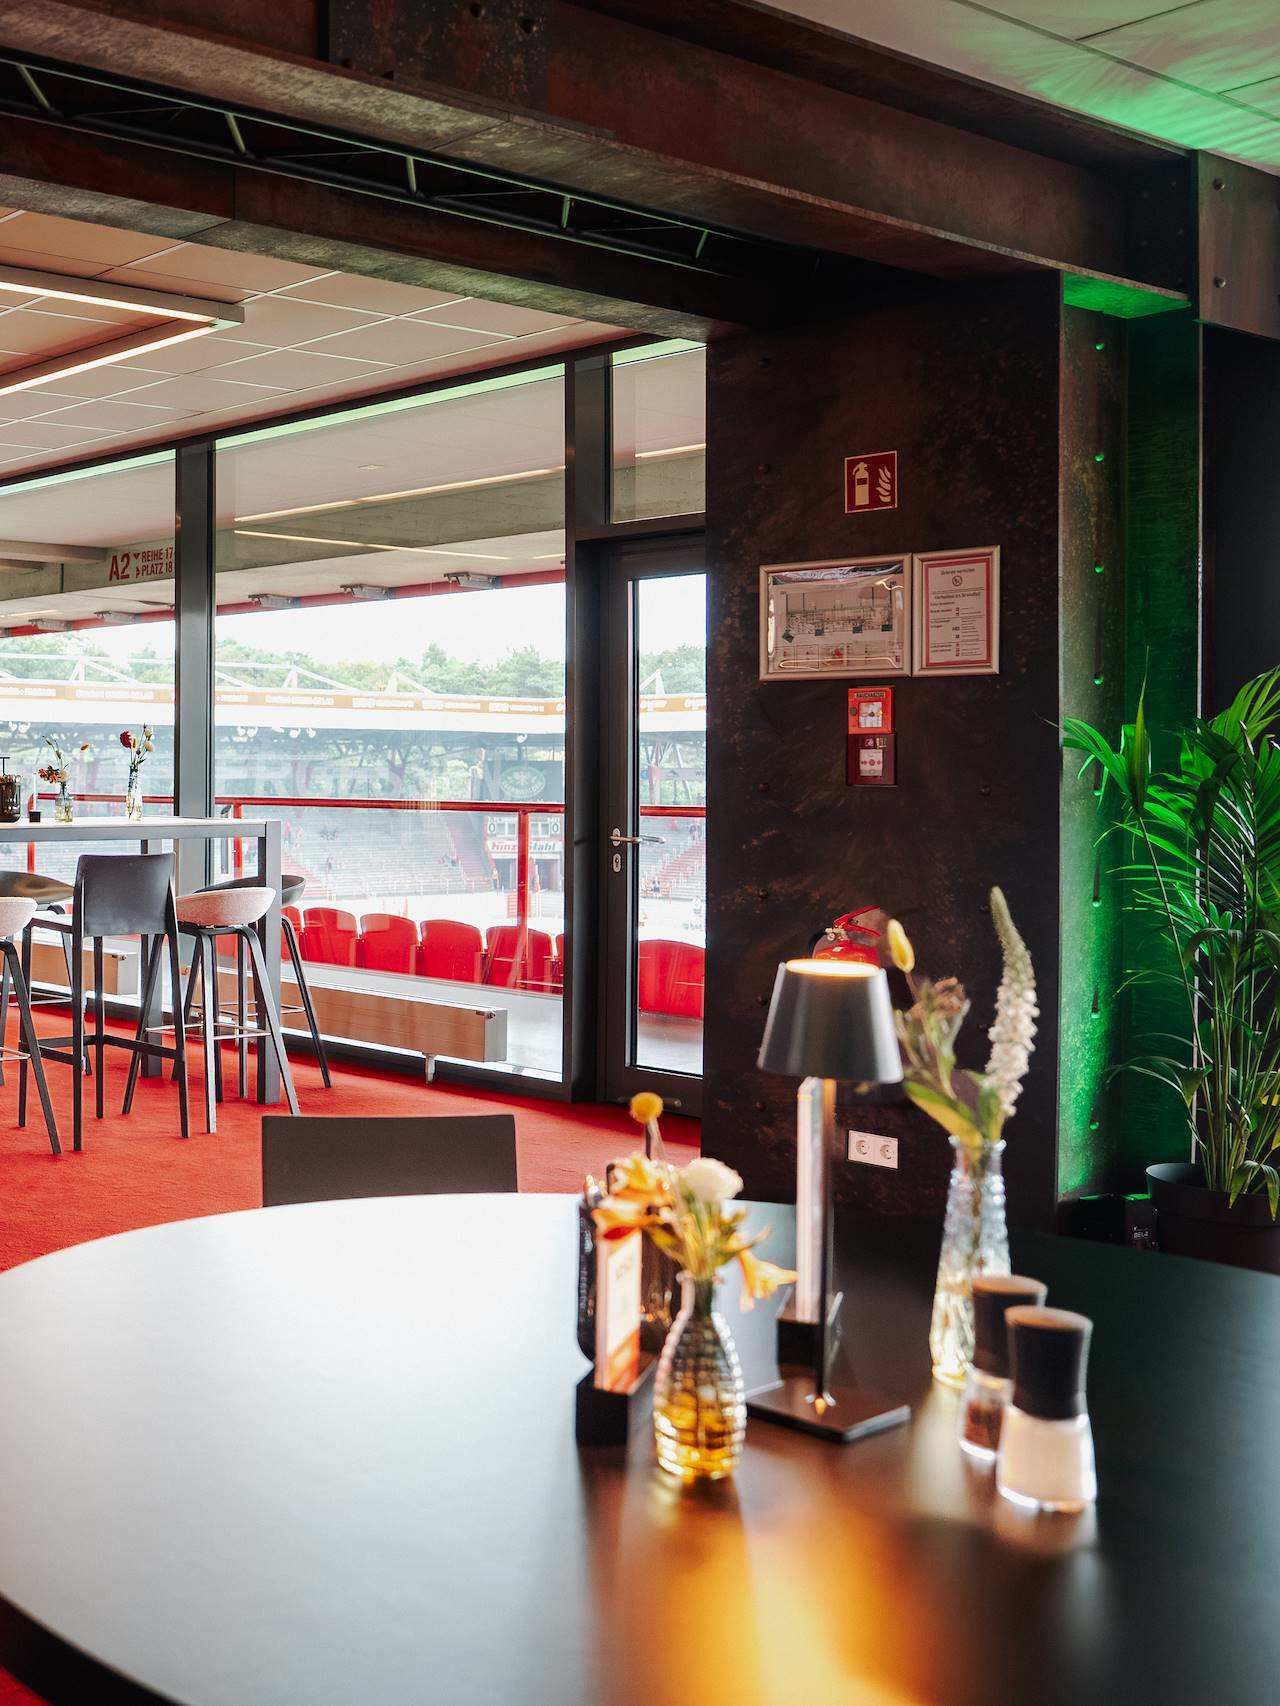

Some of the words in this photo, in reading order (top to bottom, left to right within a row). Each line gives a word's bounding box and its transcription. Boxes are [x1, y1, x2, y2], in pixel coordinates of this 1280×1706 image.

[141, 548, 163, 562] REIHE
[165, 546, 173, 560] 17
[109, 552, 130, 580] A2
[141, 562, 163, 576] PLATZ
